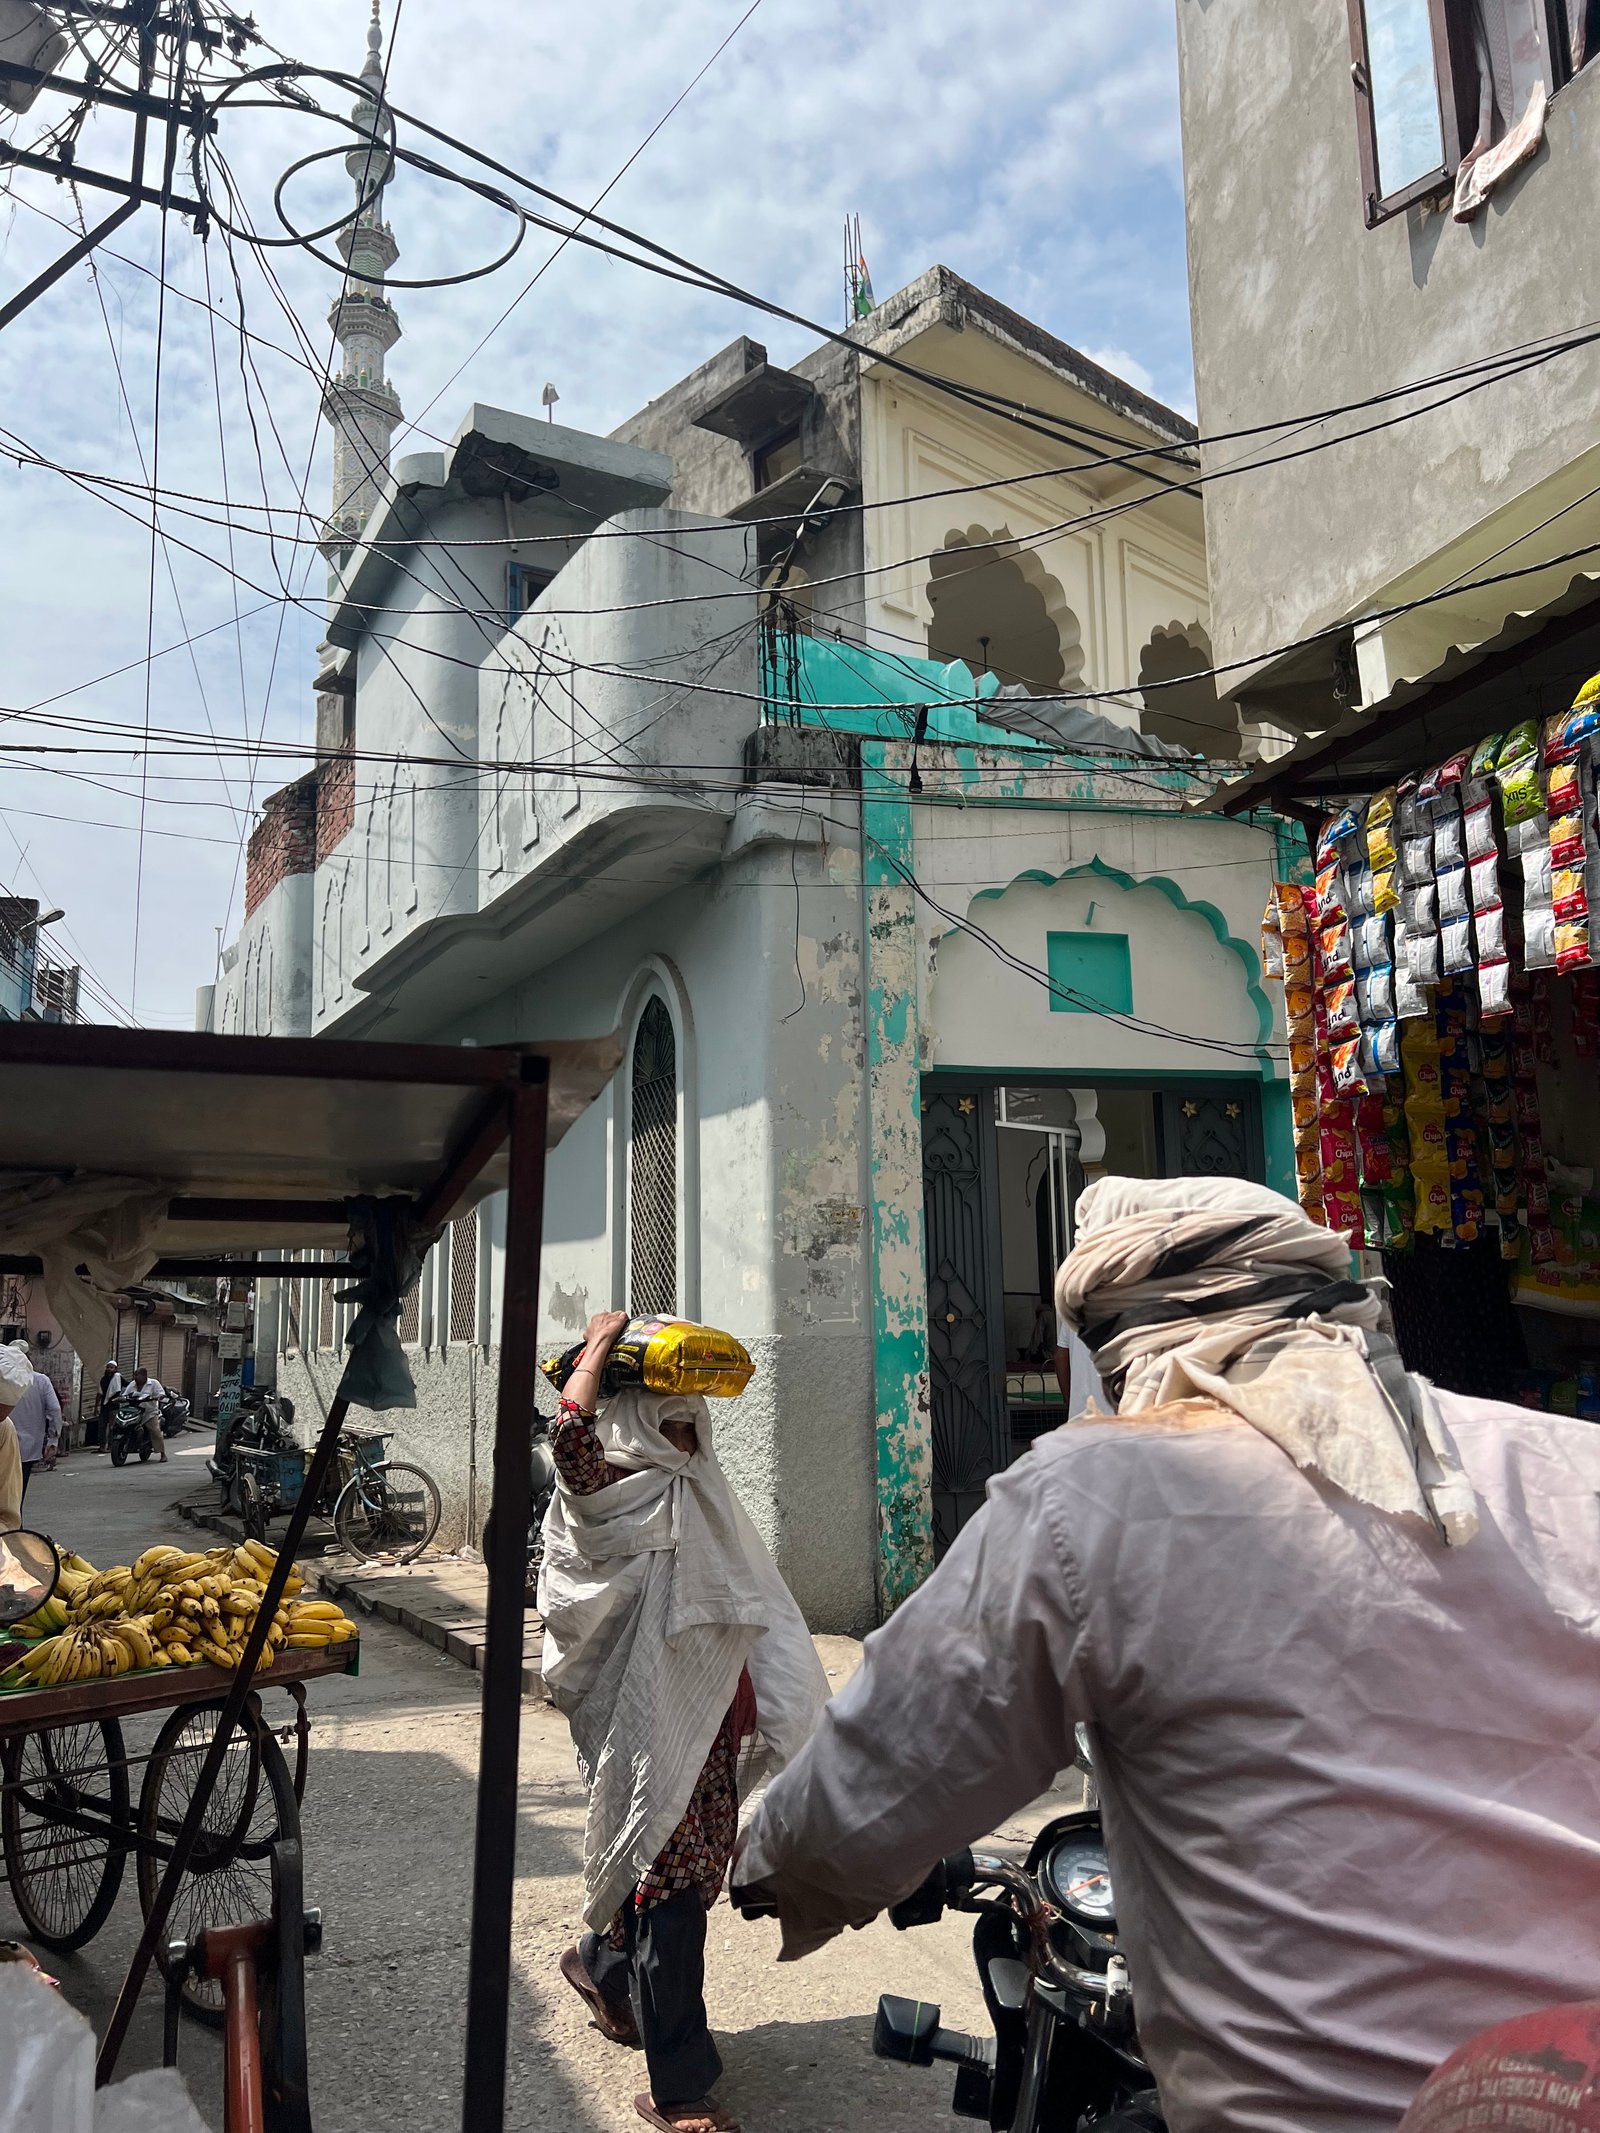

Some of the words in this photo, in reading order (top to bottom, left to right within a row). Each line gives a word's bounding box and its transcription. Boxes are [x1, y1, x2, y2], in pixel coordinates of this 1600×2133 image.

[1335, 1148, 1354, 1161] Chips
[1341, 1212, 1359, 1225] Chips
[1546, 2081, 1583, 2110] NON
